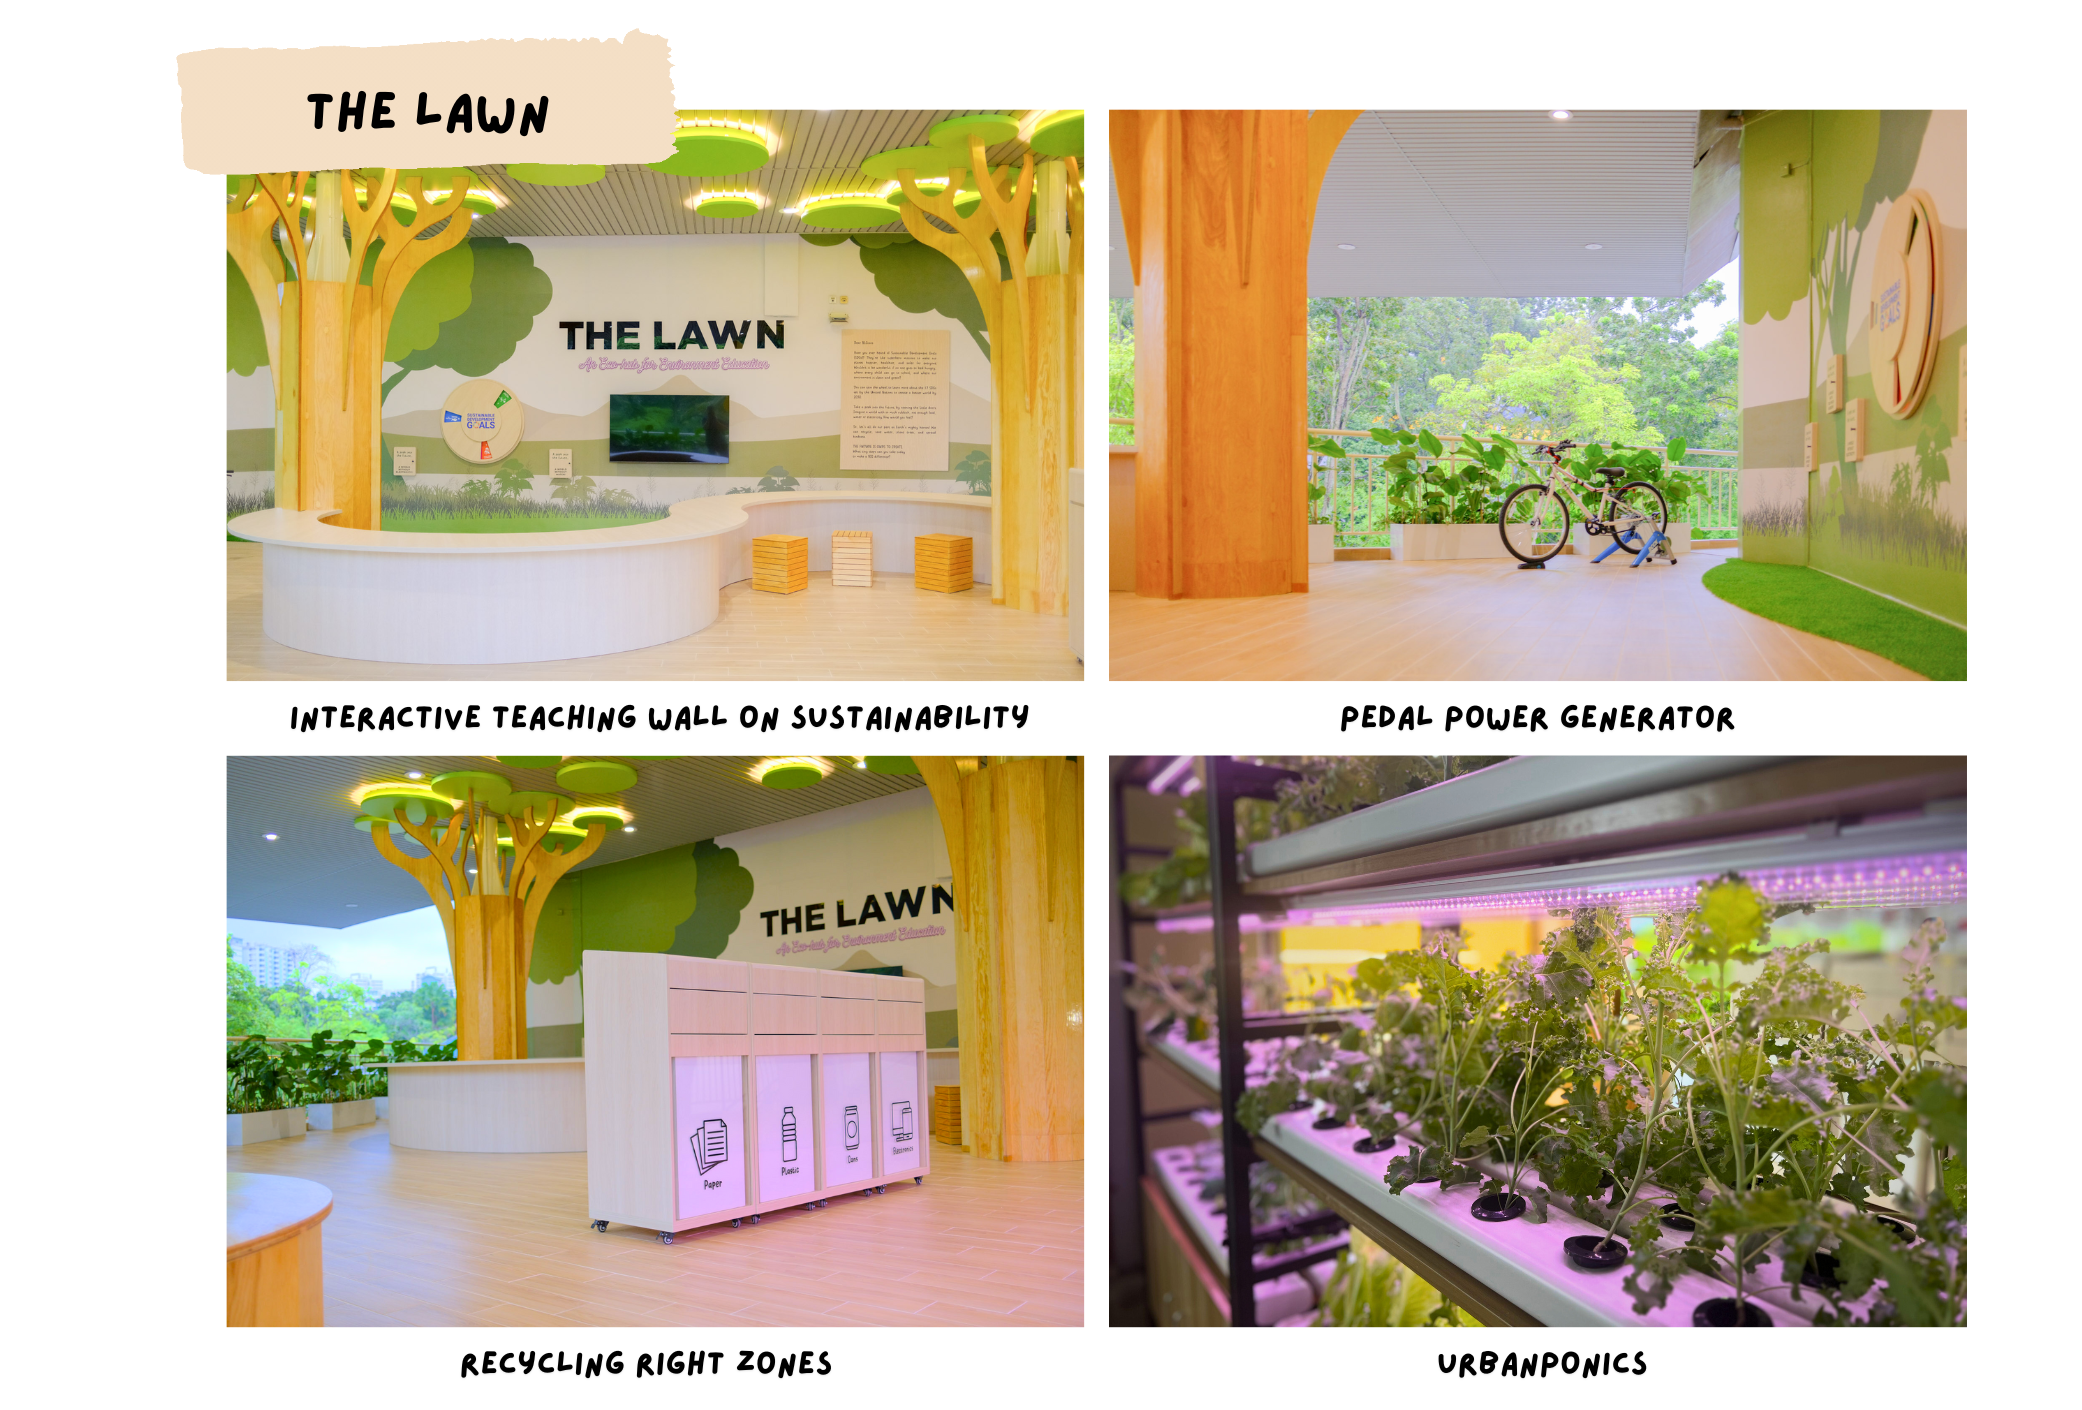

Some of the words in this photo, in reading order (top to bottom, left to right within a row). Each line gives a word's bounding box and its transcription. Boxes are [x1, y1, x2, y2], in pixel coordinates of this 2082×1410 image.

[559, 321, 640, 350] THE
[655, 320, 785, 350] LAWN
[579, 357, 597, 372] An
[599, 357, 639, 371] Eco-hub
[637, 357, 657, 374] for
[659, 357, 720, 371] Environment
[721, 357, 770, 371] Education
[467, 421, 495, 429] GOALS
[760, 902, 825, 937] THE
[837, 882, 954, 928] LAWN
[776, 942, 790, 956] An
[792, 939, 825, 953] Eco-hub
[823, 936, 840, 952] for
[842, 929, 897, 948] Environment
[898, 925, 946, 941] Education
[847, 1155, 858, 1164] Cans
[781, 1166, 800, 1176] Plastic
[704, 1179, 722, 1190] Paper
